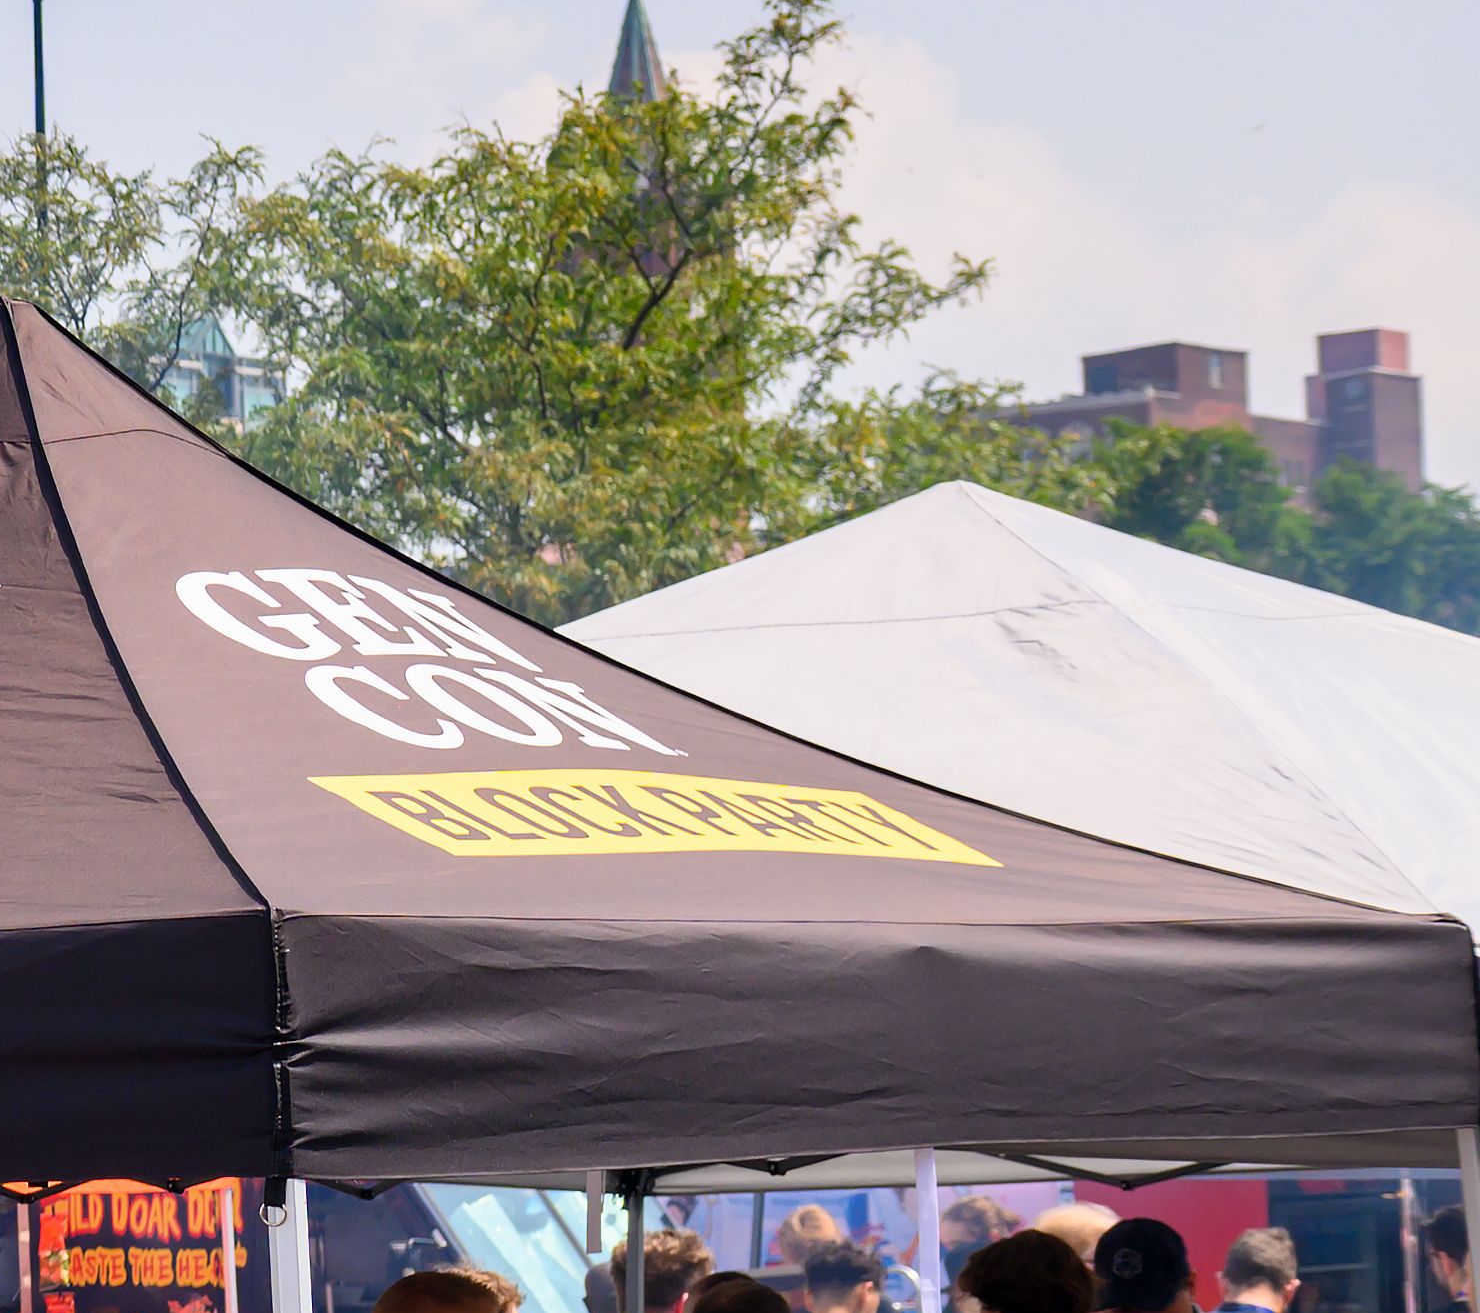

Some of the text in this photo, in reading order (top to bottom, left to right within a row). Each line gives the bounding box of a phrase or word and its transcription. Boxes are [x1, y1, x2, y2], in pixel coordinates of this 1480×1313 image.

[175, 568, 543, 674] GEN
[304, 664, 680, 757] CON
[368, 784, 940, 851] BLOCK PARTY
[68, 1244, 247, 1289] ASTE THE HEA
